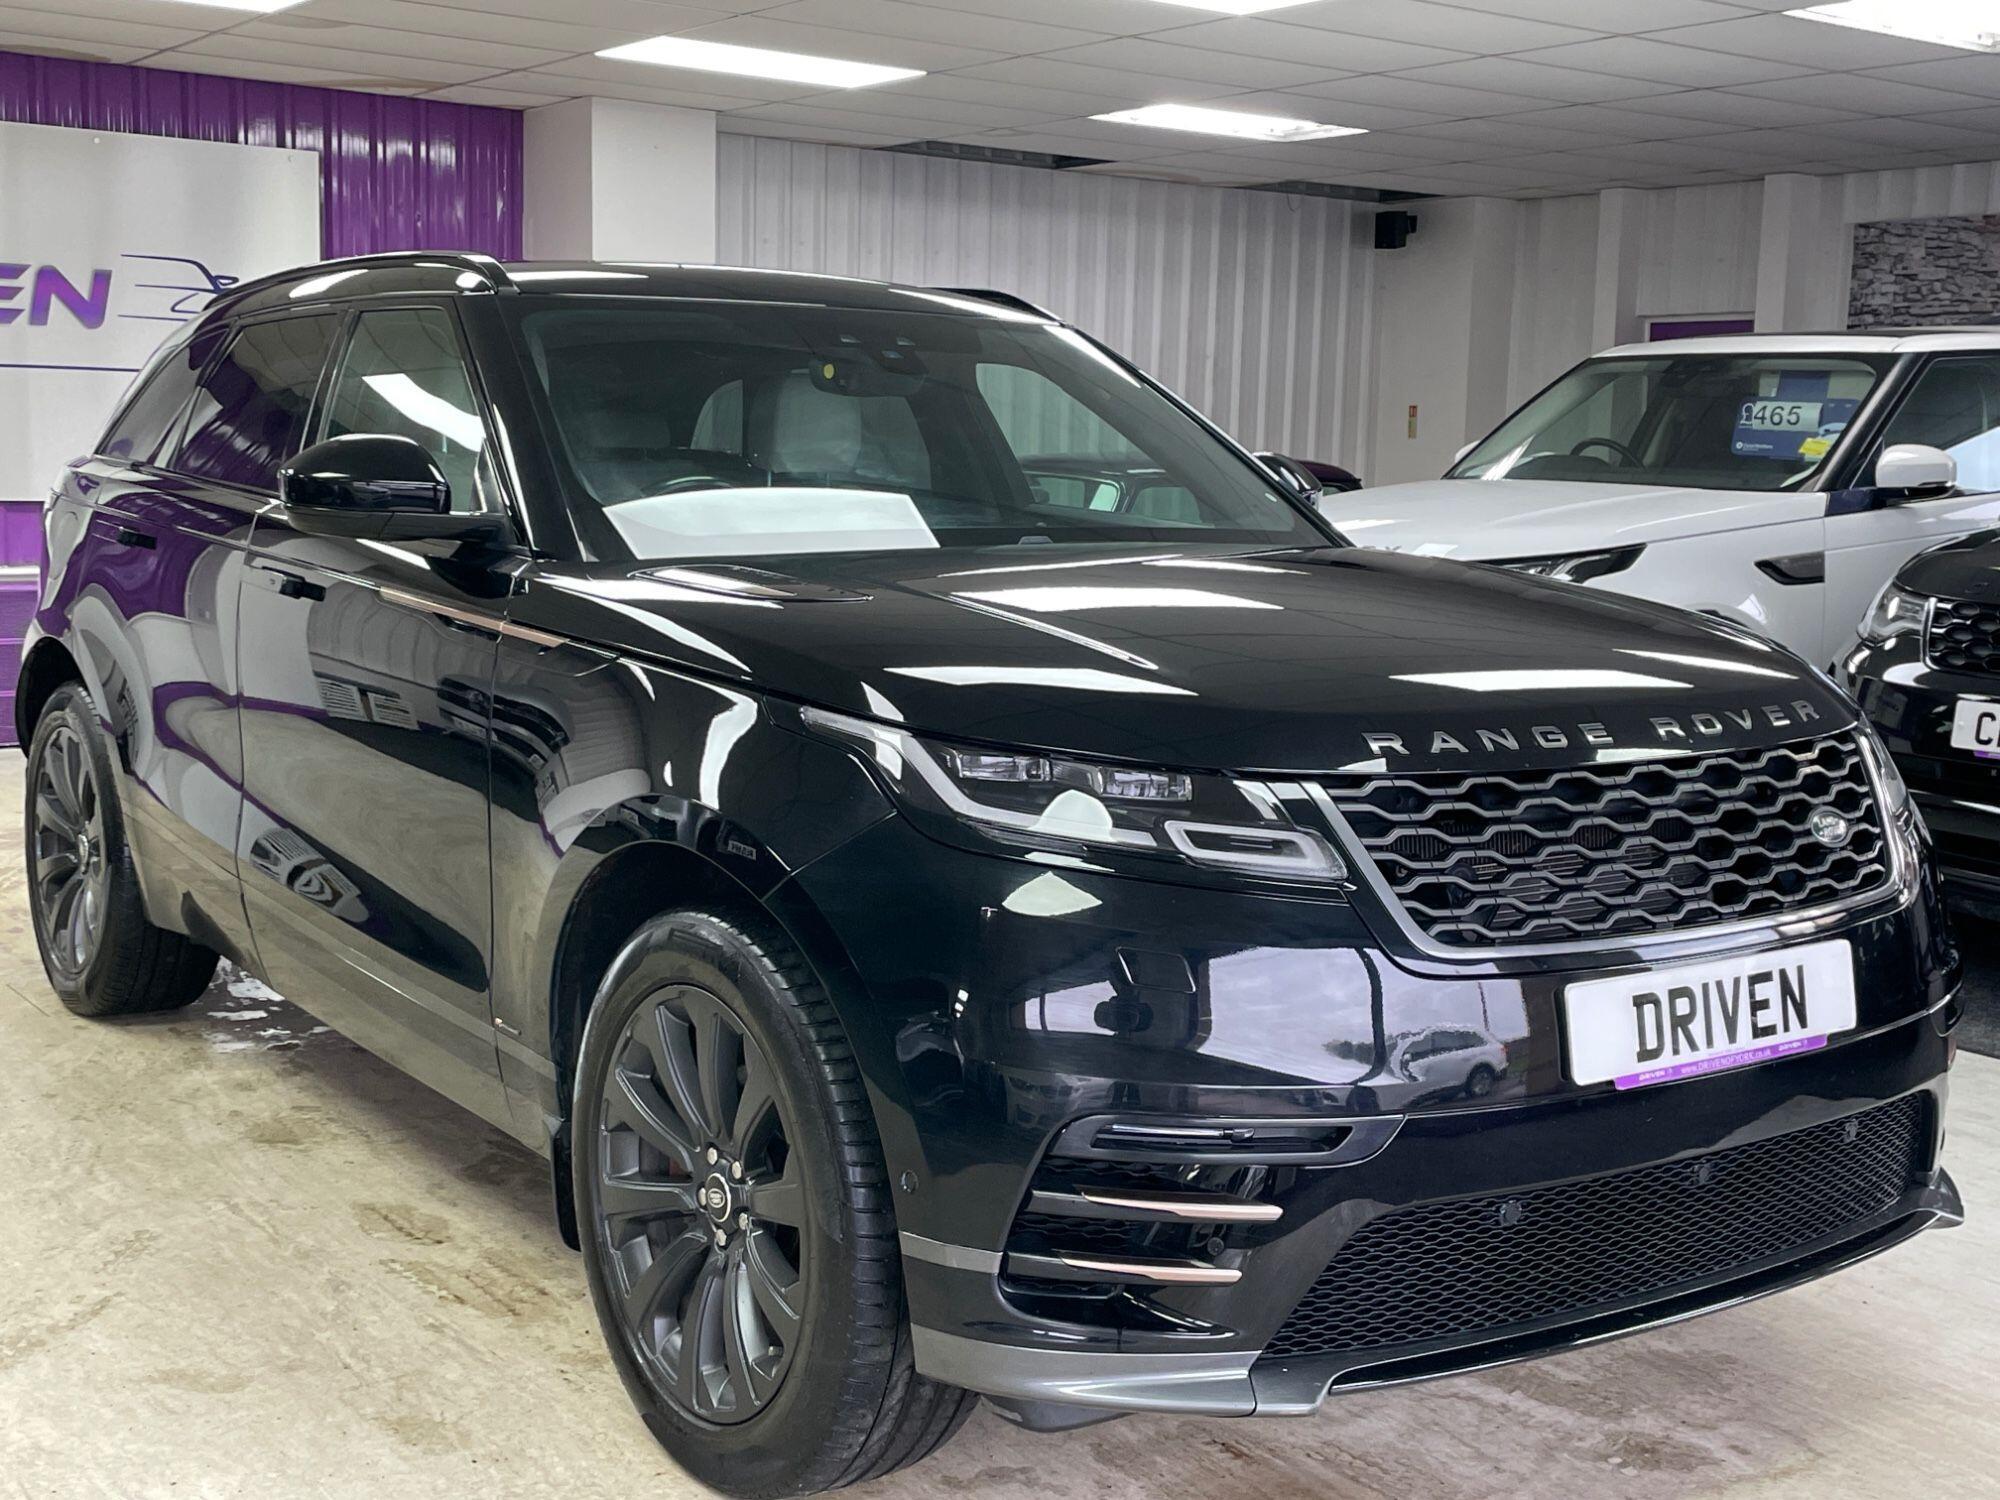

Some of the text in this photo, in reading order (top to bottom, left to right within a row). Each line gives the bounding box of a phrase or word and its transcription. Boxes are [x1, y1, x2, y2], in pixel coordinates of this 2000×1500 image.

[1739, 402, 1802, 426] £465
[1360, 699, 1821, 756] RANGE ROVER
[1632, 964, 1808, 1064] DRIVEN
